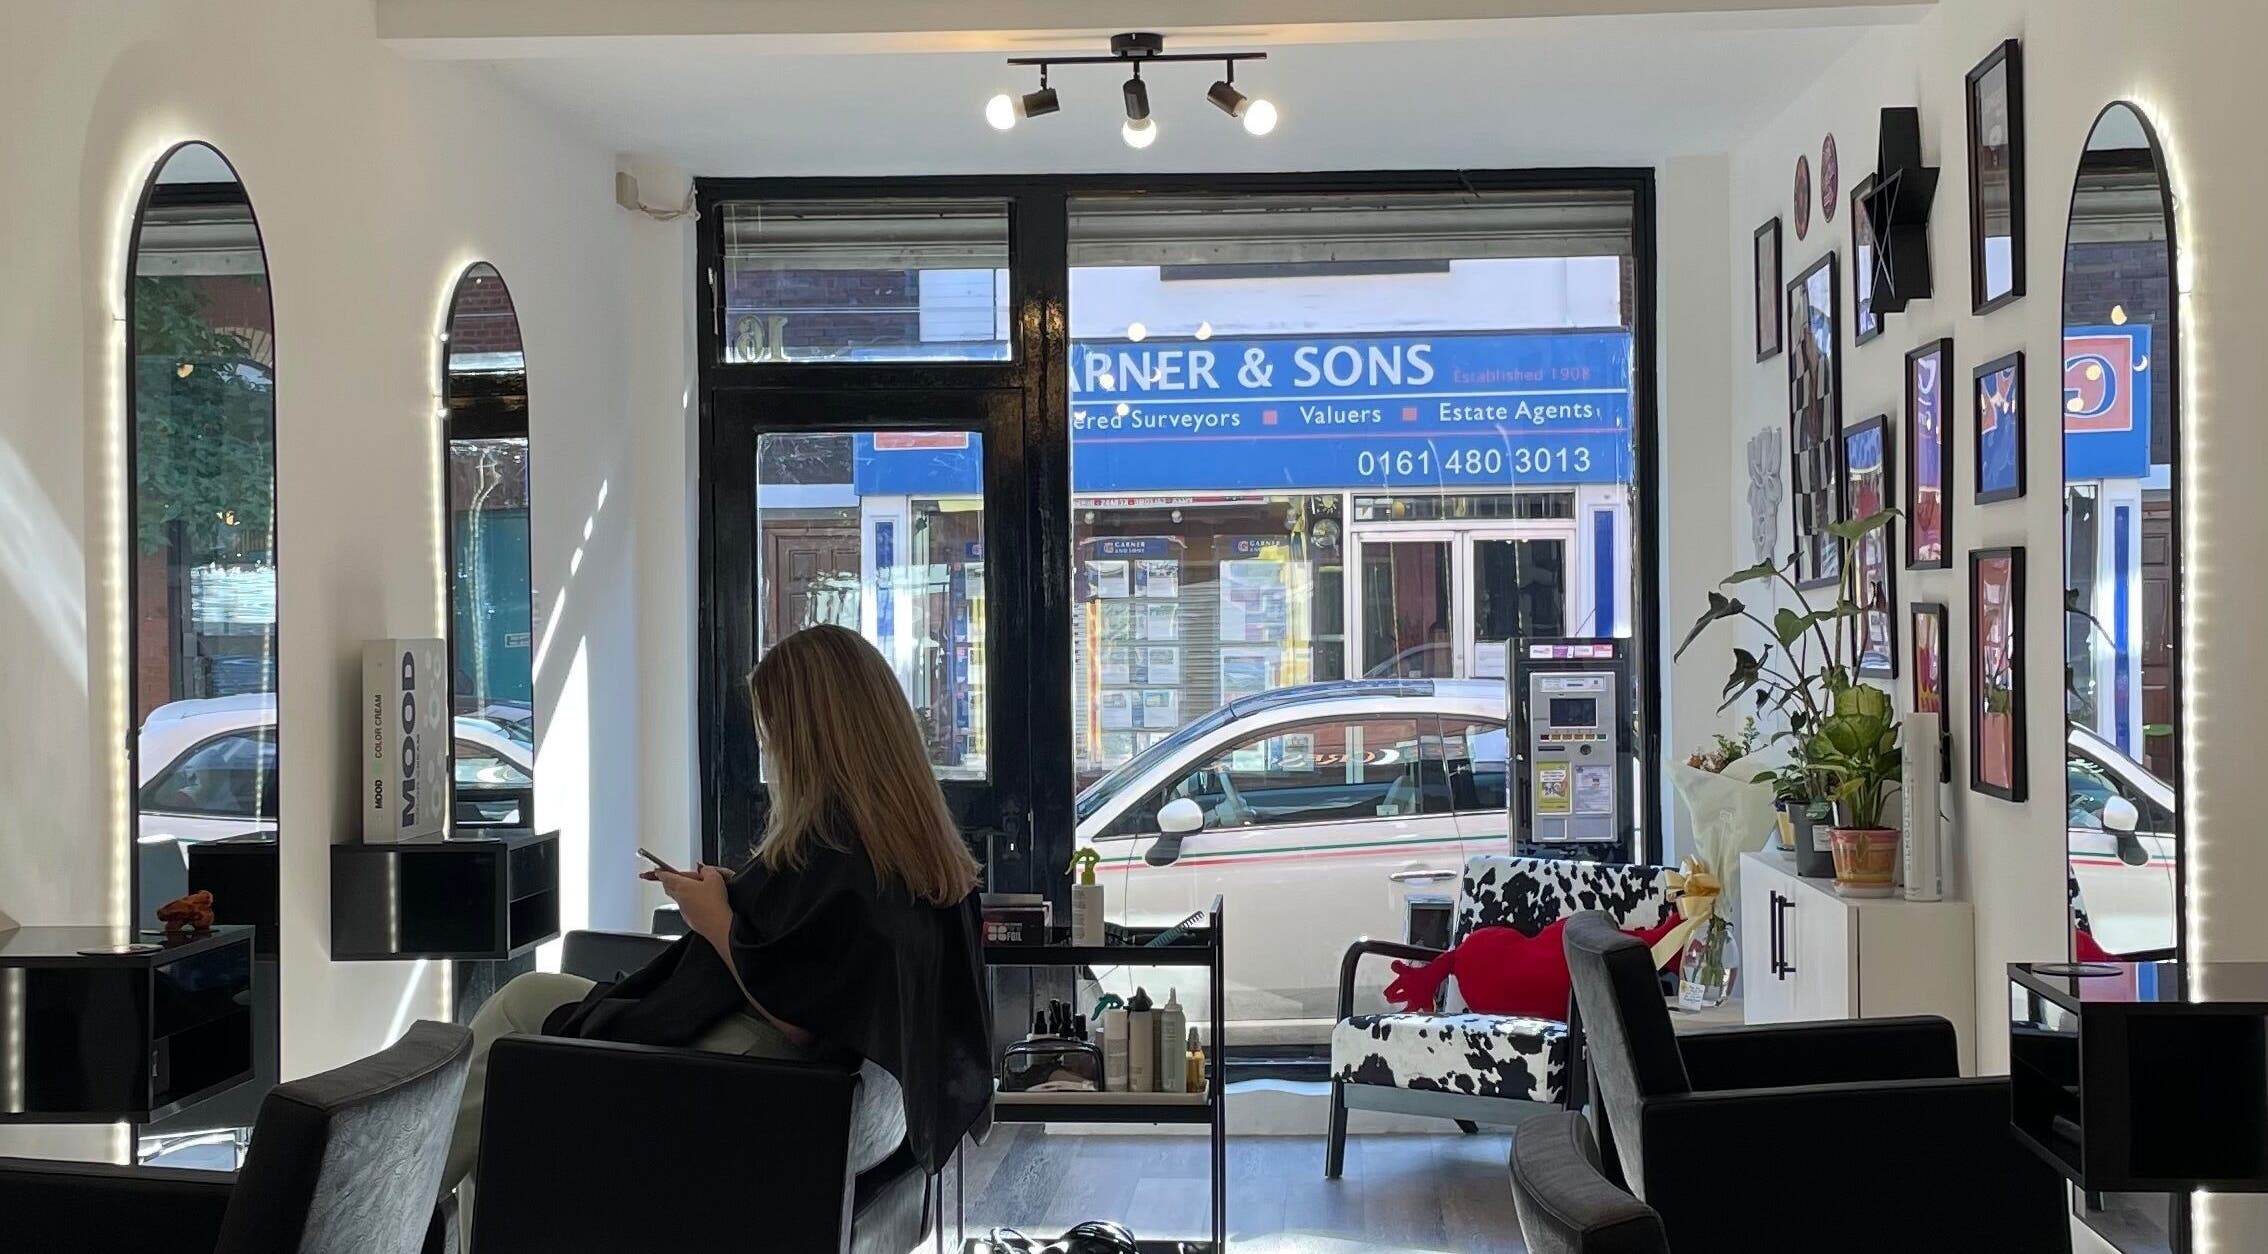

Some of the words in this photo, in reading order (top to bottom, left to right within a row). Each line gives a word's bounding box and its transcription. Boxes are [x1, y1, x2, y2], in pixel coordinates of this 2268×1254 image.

[1237, 347, 1274, 389] &
[1293, 344, 1435, 388] SONS
[1454, 368, 1544, 384] Established
[1552, 367, 1592, 382] 1908
[1131, 409, 1241, 433] Surveyors
[1299, 405, 1382, 425] Valuers
[1439, 402, 1508, 422] Estate
[1514, 399, 1594, 425] Agents
[1358, 449, 1429, 476] 0161
[1445, 449, 1502, 475] 480
[1514, 447, 1591, 474] 3013
[374, 694, 383, 726] CREAM
[374, 727, 383, 759] COLOR
[401, 651, 416, 828] MOOD
[375, 779, 383, 809] MOOD
